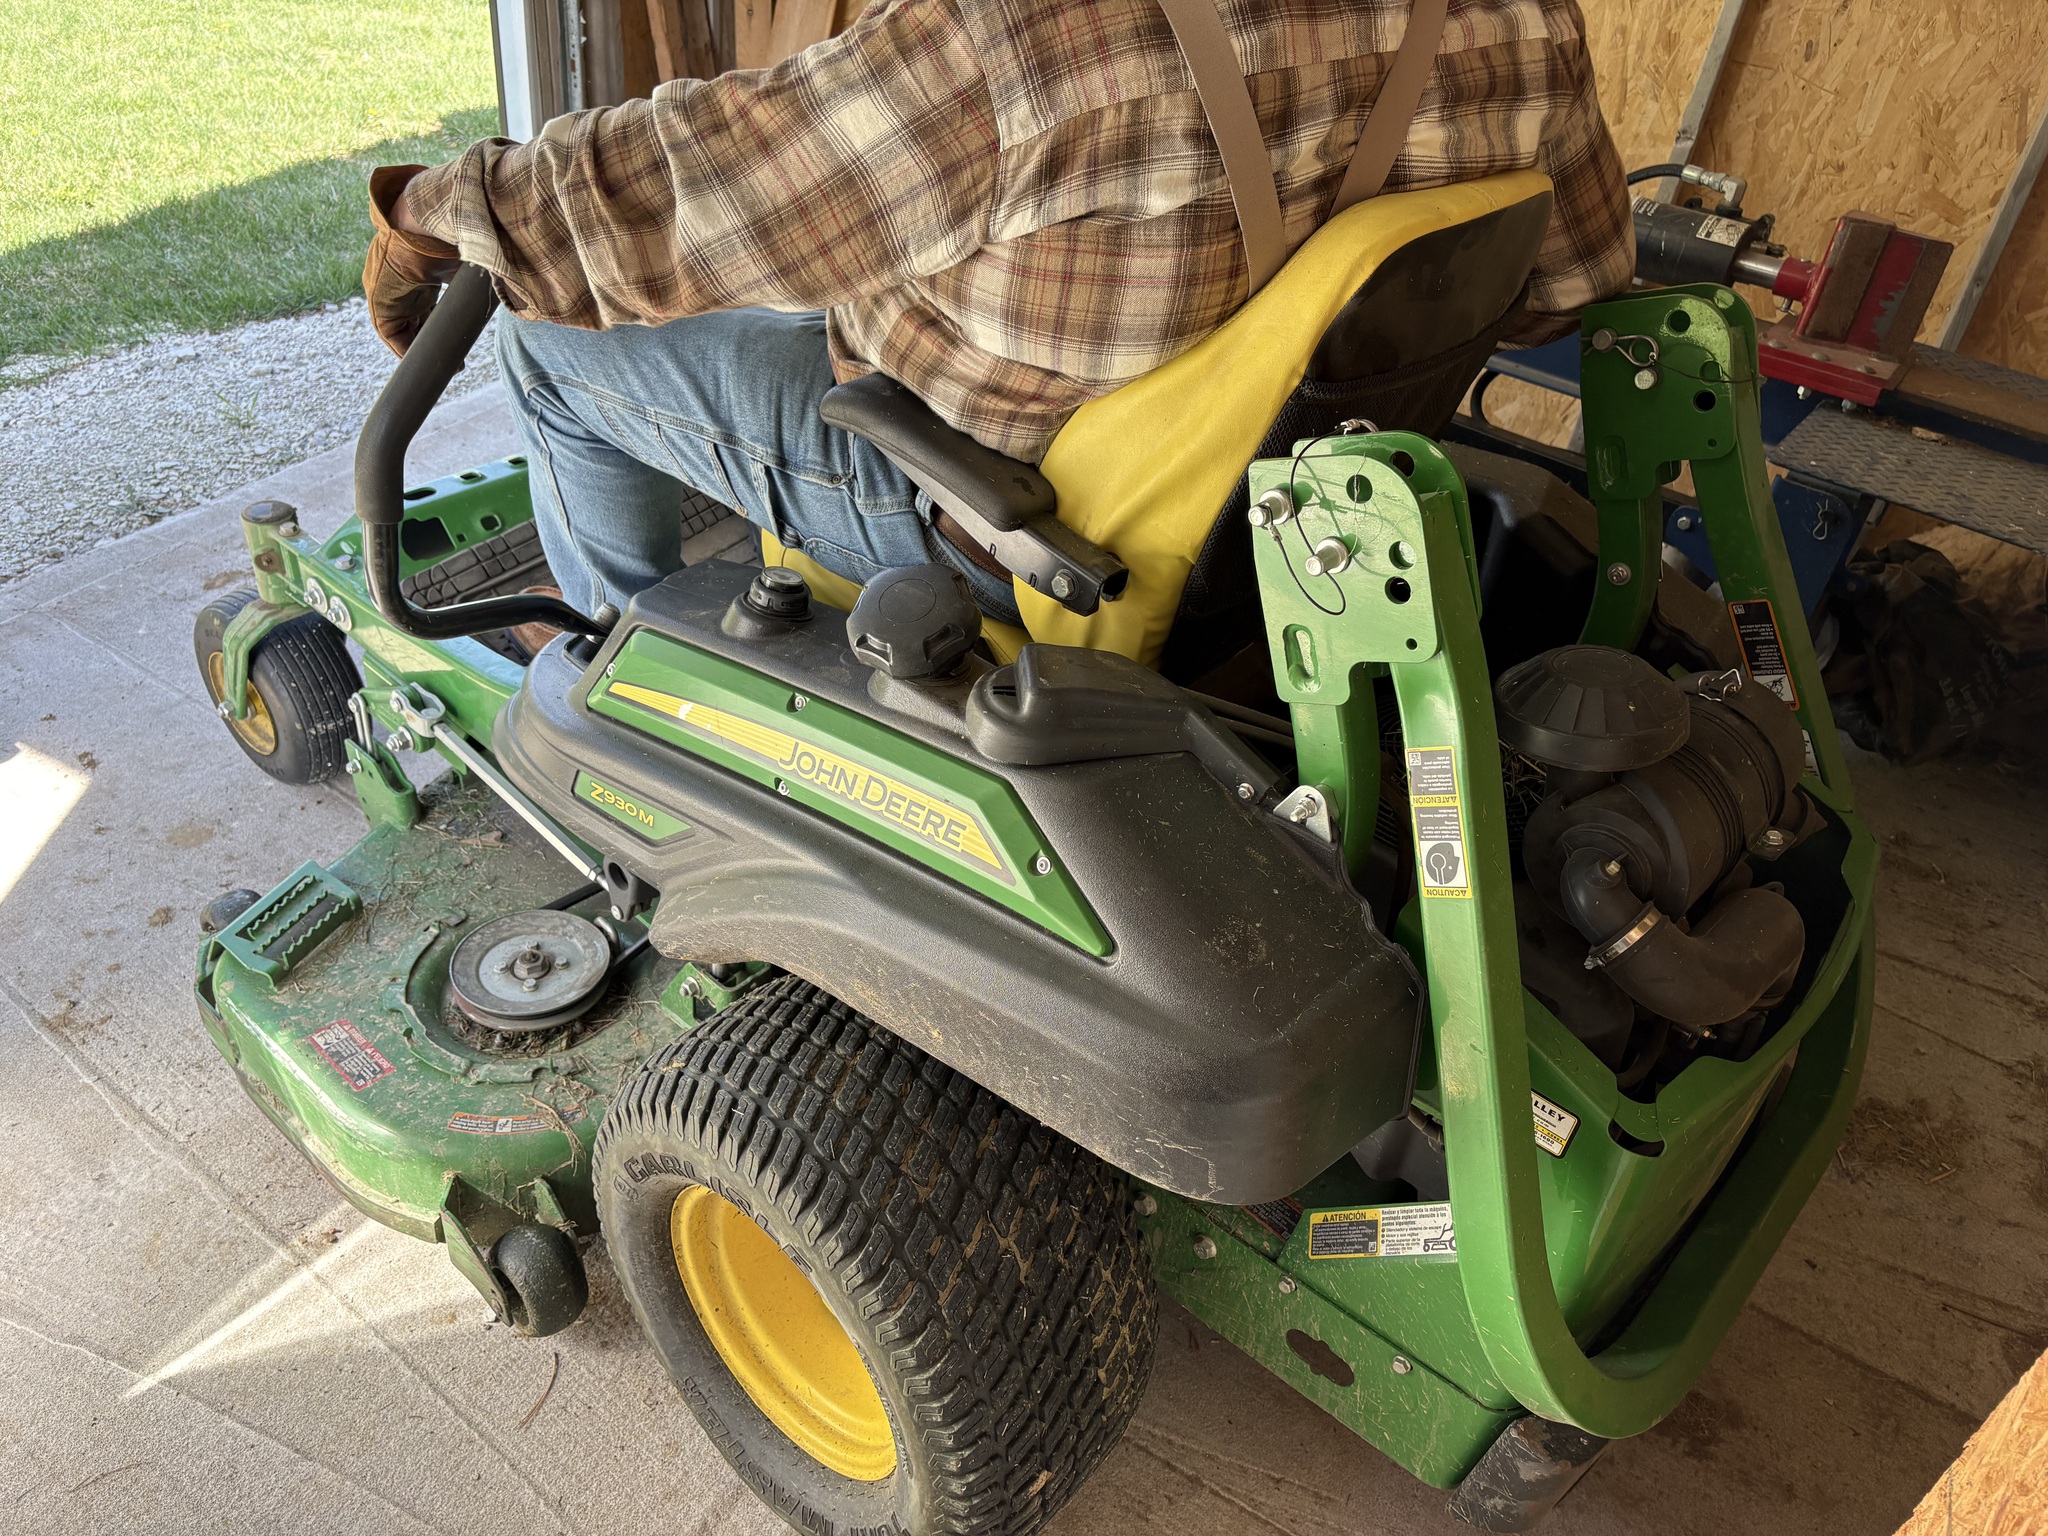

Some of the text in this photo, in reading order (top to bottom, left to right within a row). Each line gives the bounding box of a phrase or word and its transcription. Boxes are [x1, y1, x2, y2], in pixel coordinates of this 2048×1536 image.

[590, 781, 655, 828] Z930M
[778, 740, 968, 848] JOHN DEERE
[1426, 888, 1461, 897] CAUTION
[1533, 1100, 1566, 1122] LLEY
[1330, 1210, 1367, 1222] ATENCIÓN
